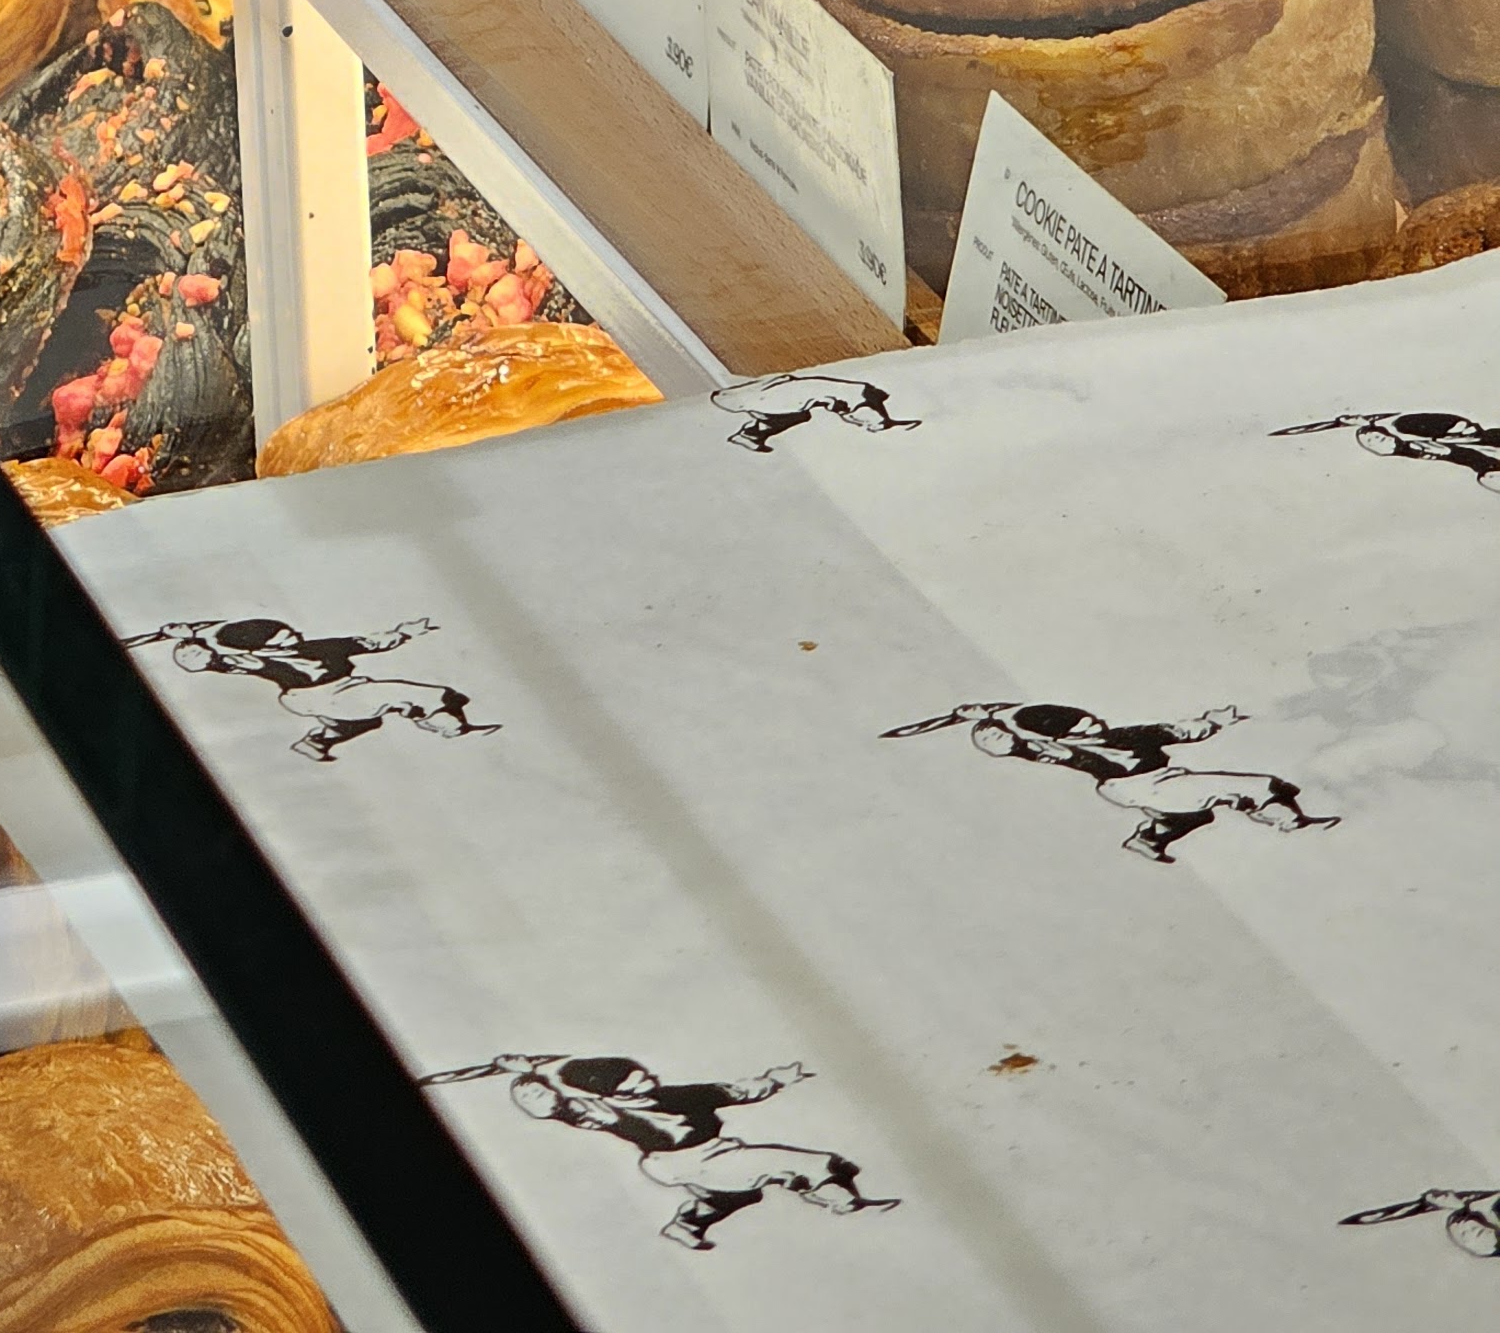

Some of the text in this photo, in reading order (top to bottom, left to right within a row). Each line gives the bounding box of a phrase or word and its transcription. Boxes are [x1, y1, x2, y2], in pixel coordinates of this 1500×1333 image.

[1000, 260, 1023, 295] PATE
[1020, 282, 1029, 303] A
[1015, 180, 1172, 315] COOKIE PATE A TARTIN
